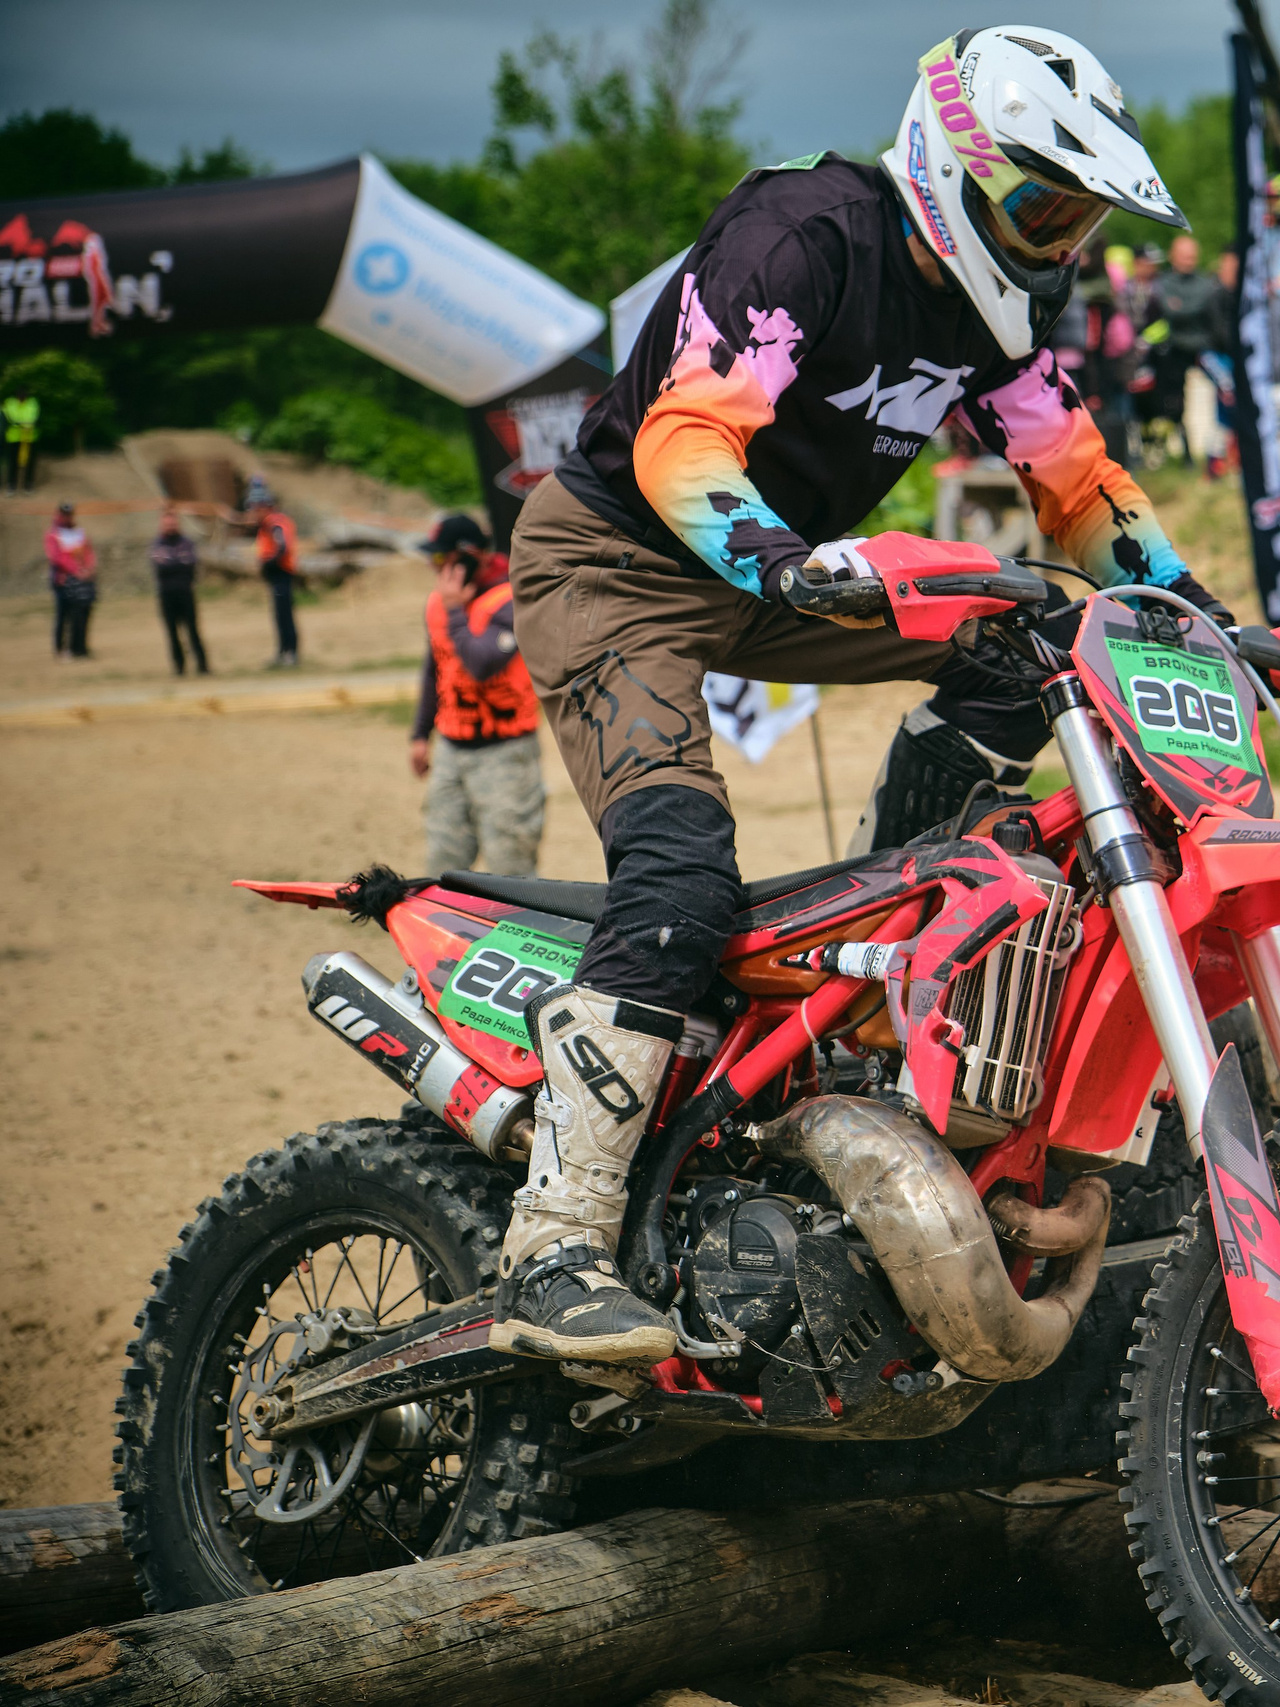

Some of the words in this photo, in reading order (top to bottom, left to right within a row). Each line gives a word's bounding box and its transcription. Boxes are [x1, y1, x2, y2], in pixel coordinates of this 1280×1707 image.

[926, 54, 1010, 178] 100%
[1144, 657, 1209, 681] BRONZE
[1133, 679, 1238, 743] 206
[461, 1006, 492, 1025] Рада
[736, 1251, 774, 1262] Beta
[1226, 1651, 1268, 1686] Mitas
